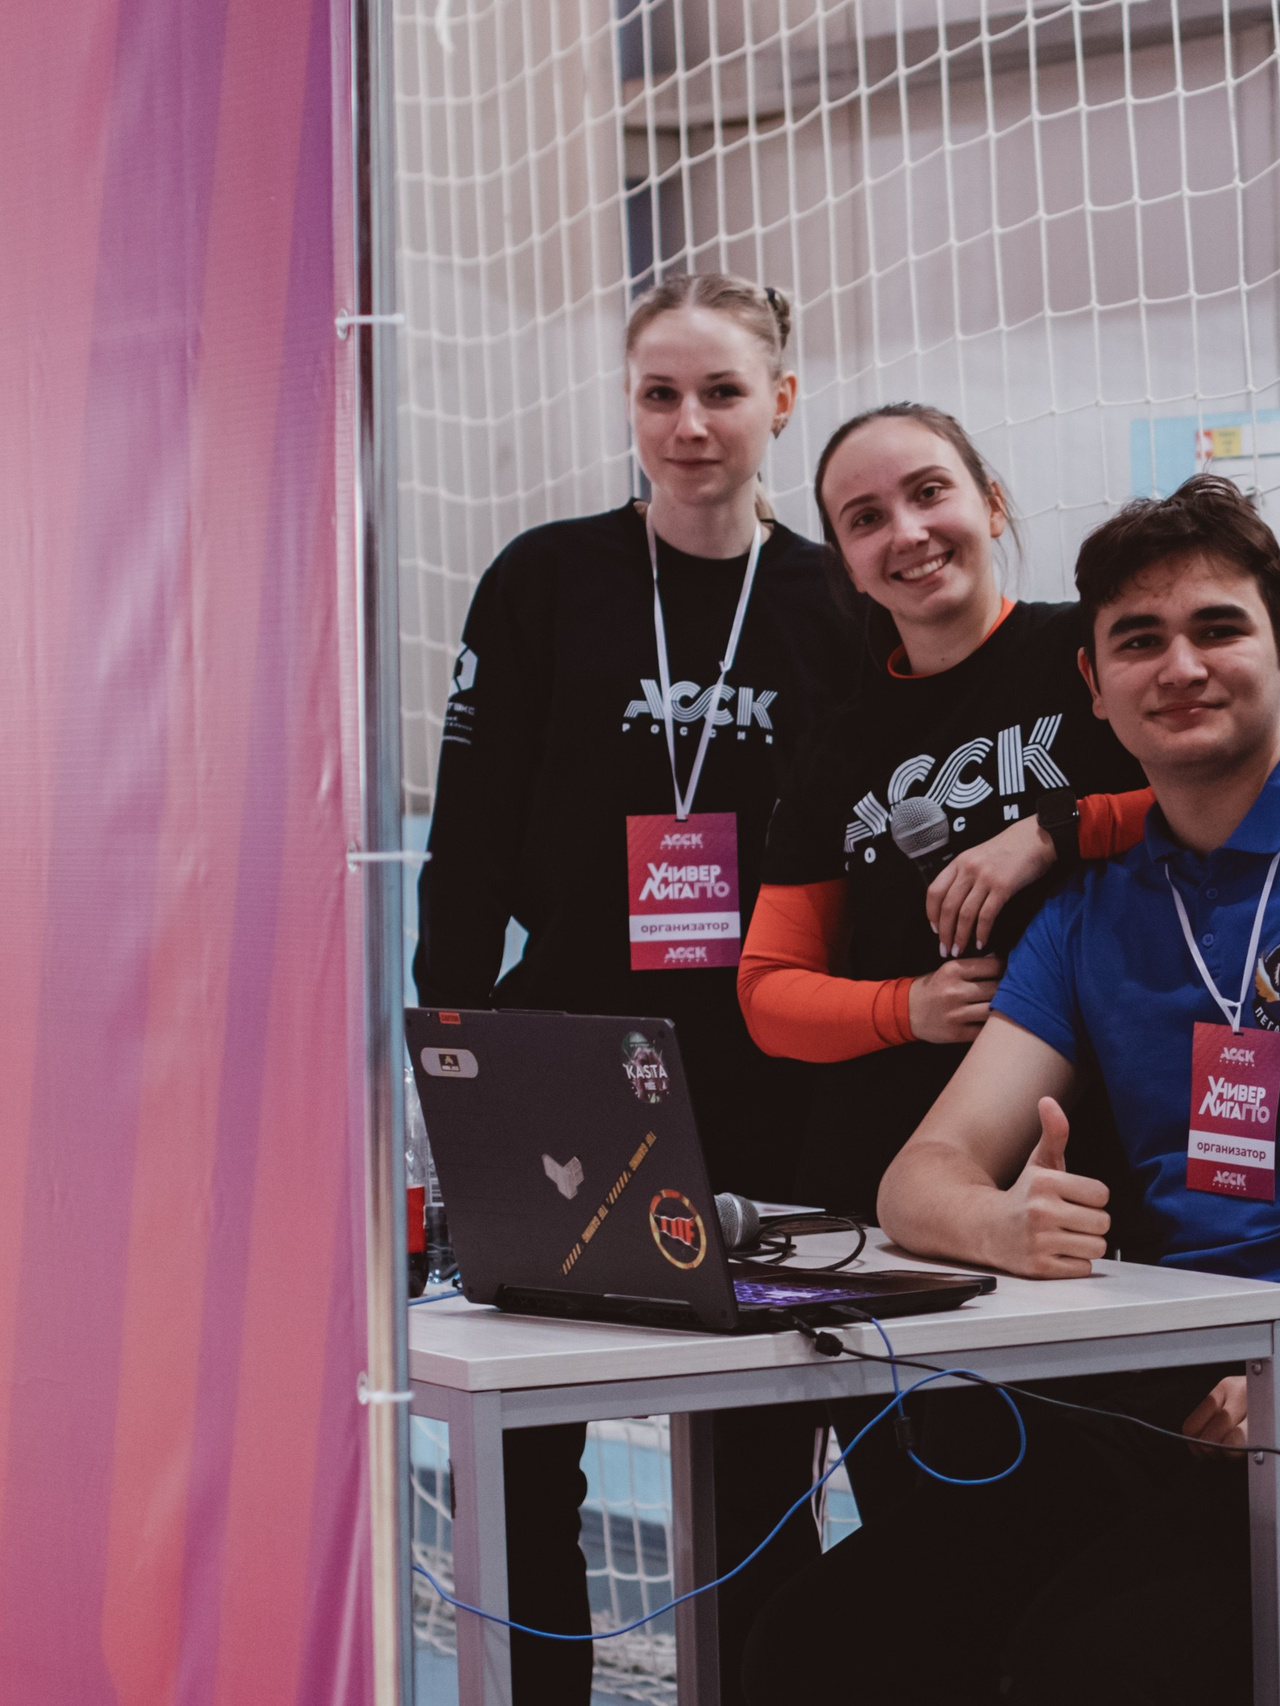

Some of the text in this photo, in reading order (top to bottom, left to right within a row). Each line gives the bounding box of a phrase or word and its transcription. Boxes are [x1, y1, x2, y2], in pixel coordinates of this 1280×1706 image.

[623, 678, 778, 730] АССК
[621, 722, 773, 744] РОССИИ
[641, 921, 729, 935] организатор
[1220, 1047, 1255, 1062] АССК
[1197, 1142, 1266, 1162] организатор
